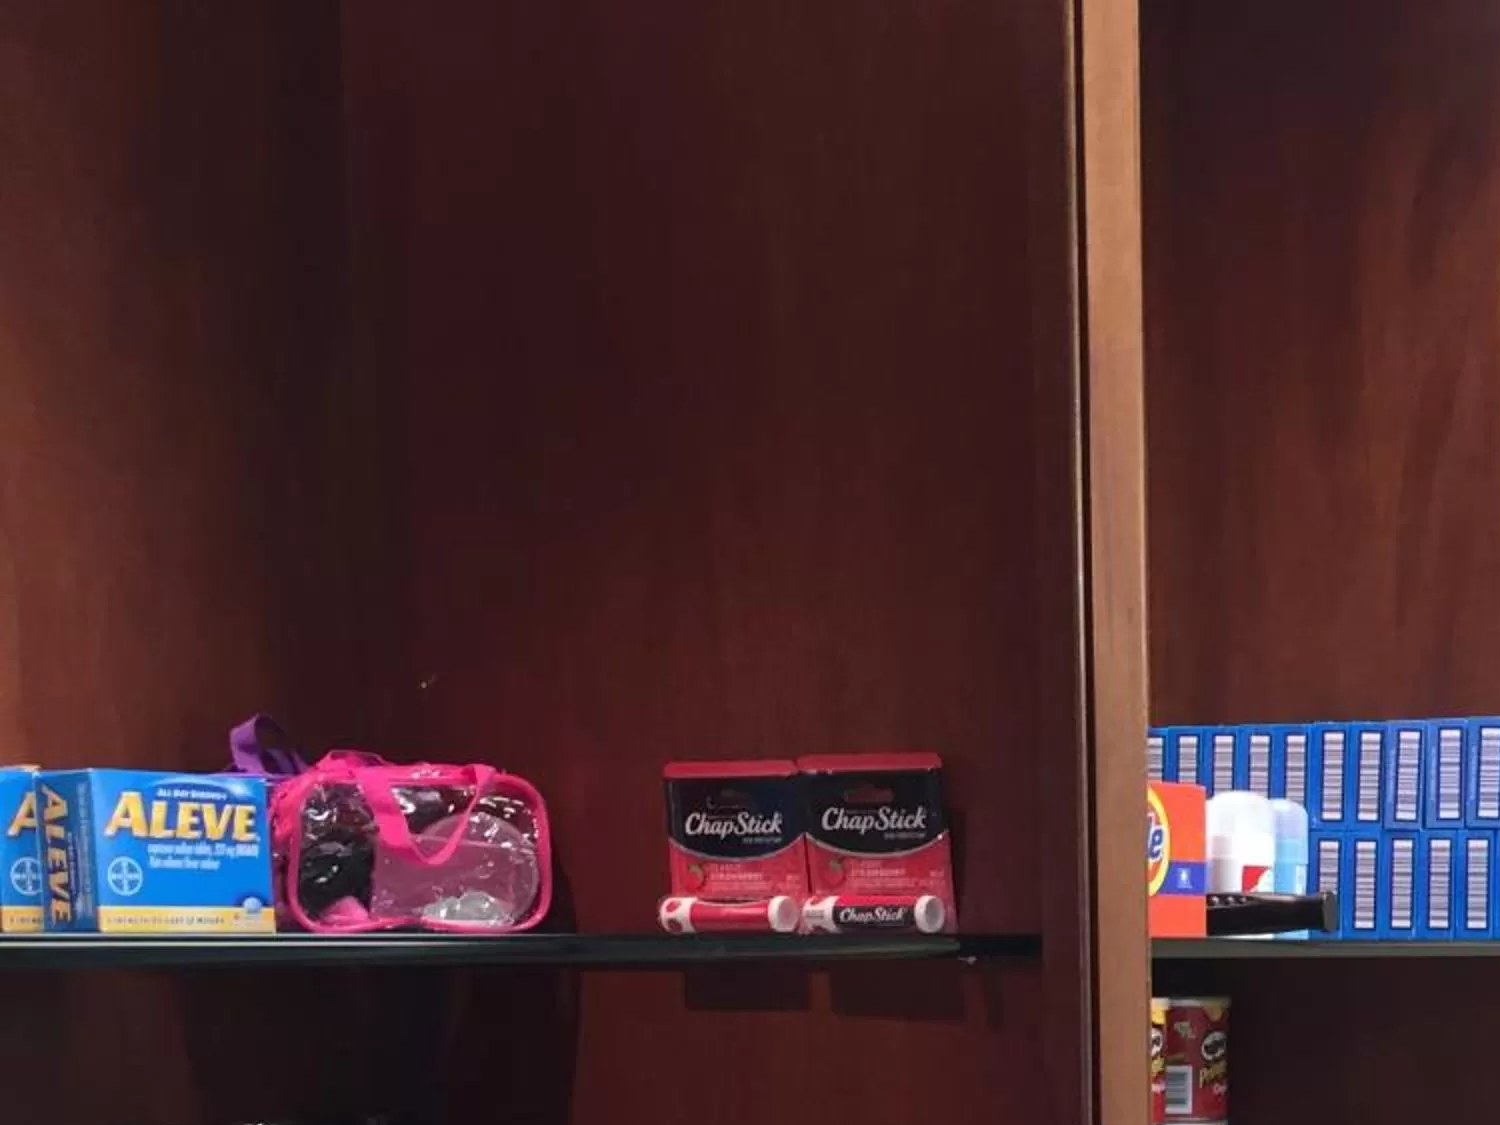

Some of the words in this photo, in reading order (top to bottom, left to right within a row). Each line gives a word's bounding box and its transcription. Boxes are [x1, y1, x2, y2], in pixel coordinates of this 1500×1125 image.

[103, 791, 257, 842] ALEVE
[684, 812, 783, 838] ChapStick
[821, 806, 927, 835] ChapStick
[42, 784, 72, 926] ALEVE
[840, 907, 905, 925] ChapStick
